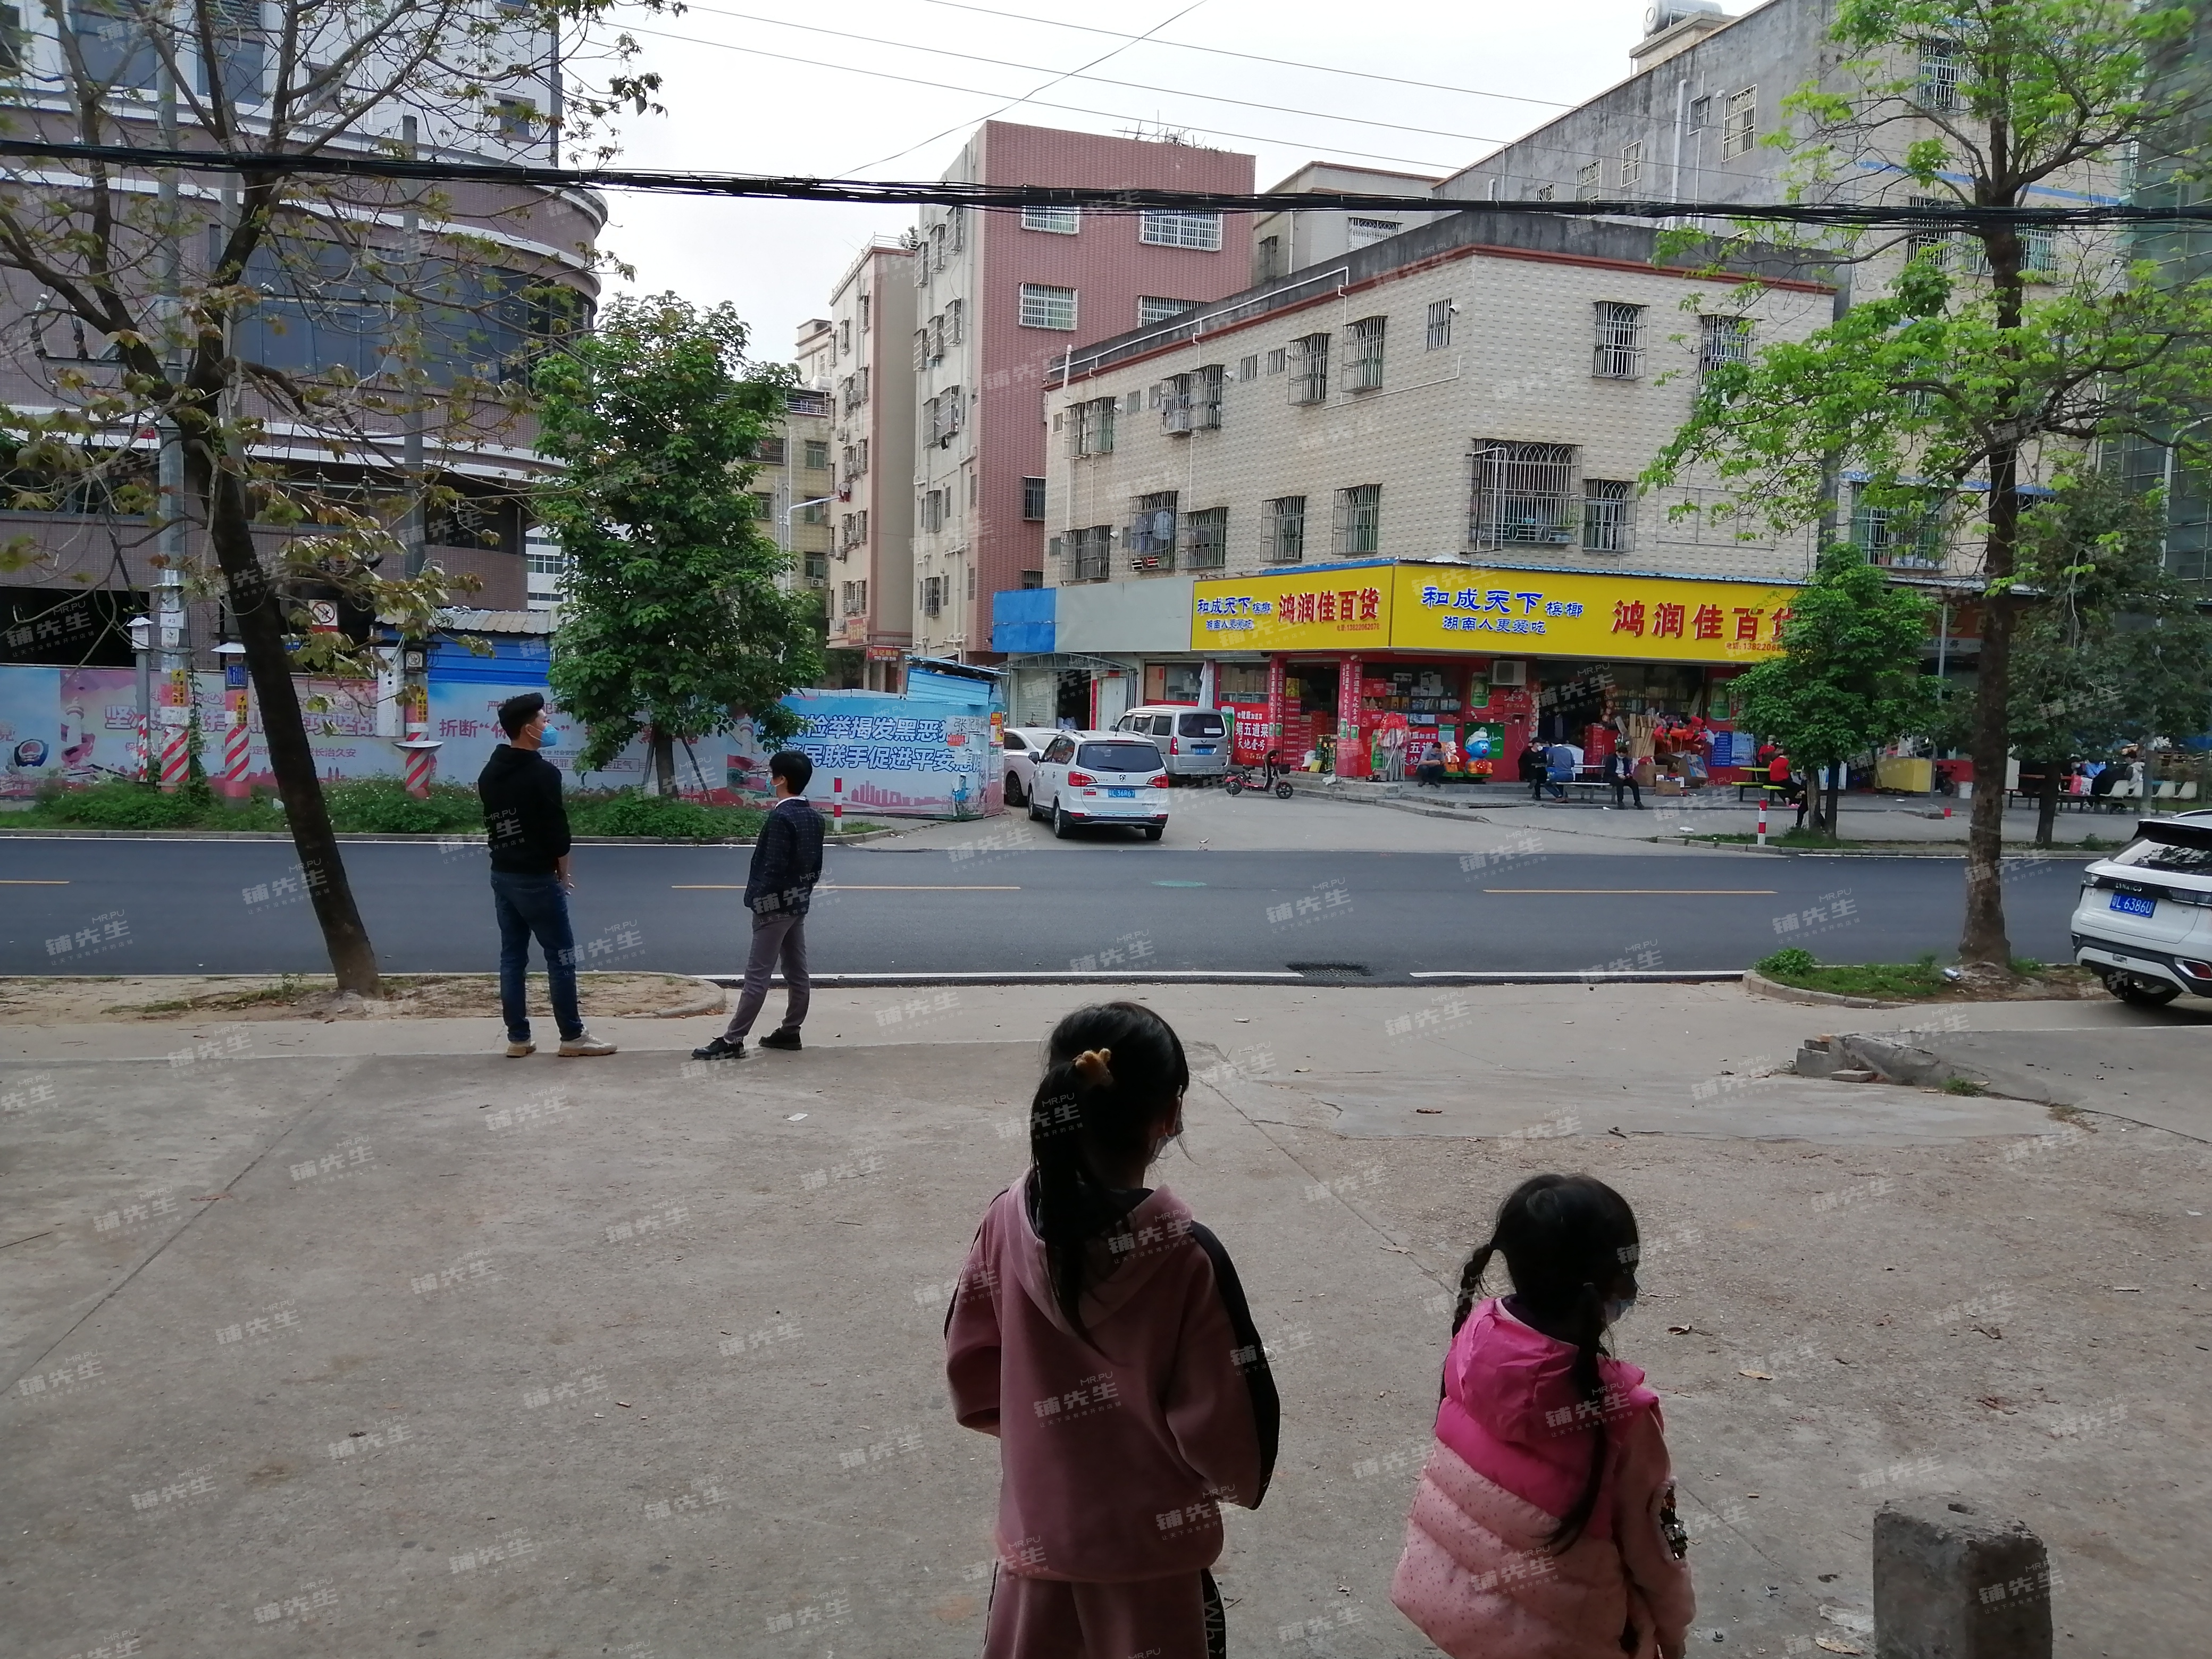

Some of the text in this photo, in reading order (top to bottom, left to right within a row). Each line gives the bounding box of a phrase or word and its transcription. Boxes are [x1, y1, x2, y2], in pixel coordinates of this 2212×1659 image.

[1197, 596, 1251, 616] 和成天下
[1278, 586, 1380, 624] 鸿润佳百货
[1421, 585, 1544, 616] 和成天下
[1442, 615, 1547, 635] 湖南人更爱吃
[1236, 722, 1269, 738] 第五道菜
[1237, 738, 1266, 751] 天地壹号
